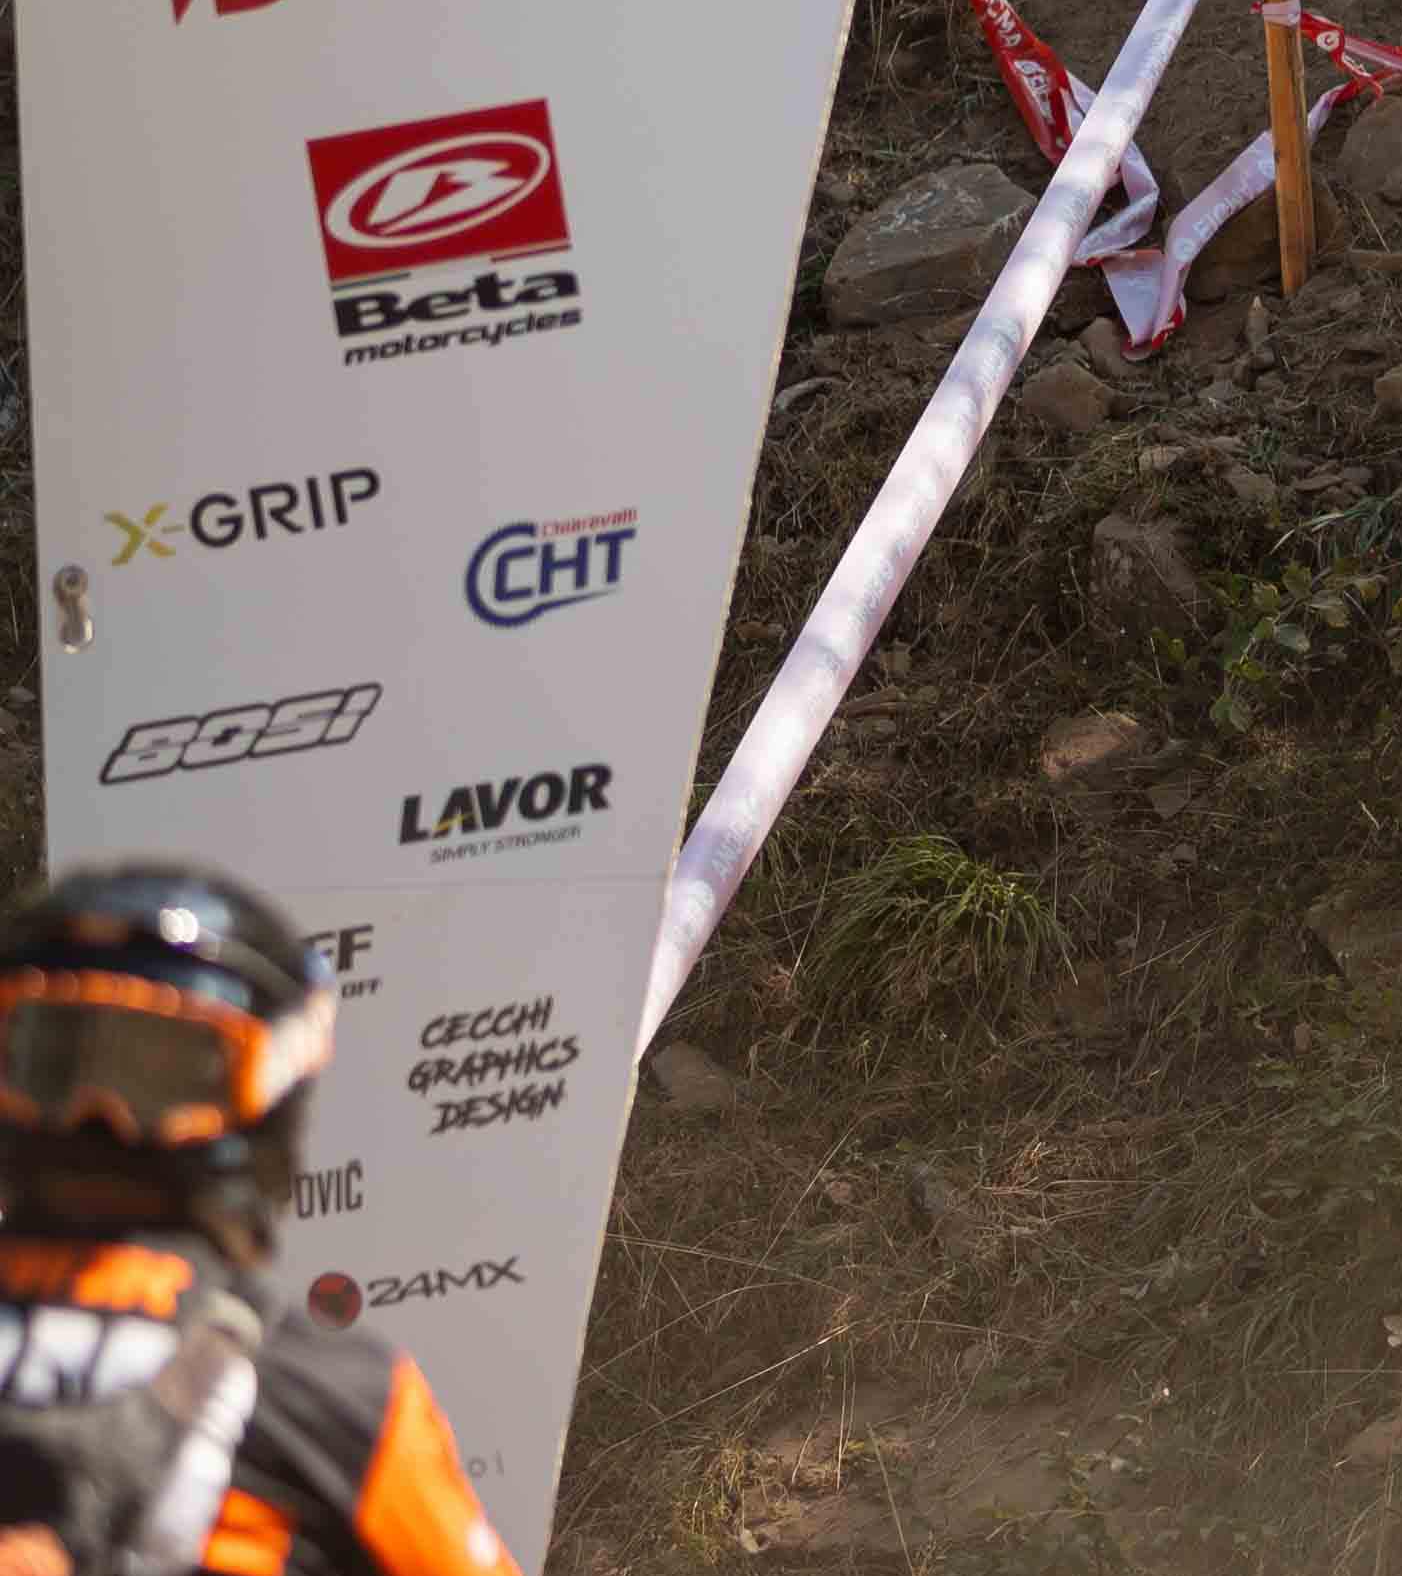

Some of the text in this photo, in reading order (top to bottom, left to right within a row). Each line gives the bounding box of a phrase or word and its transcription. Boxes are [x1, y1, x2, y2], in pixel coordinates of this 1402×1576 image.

[331, 265, 580, 338] Beta
[344, 307, 583, 367] motorcycles
[104, 467, 381, 566] X-GRIP
[397, 764, 613, 847] LAVOR
[430, 825, 582, 864] SIMPLY STRONGER
[420, 997, 554, 1048] CECCHI
[408, 1036, 580, 1091] GRAPHICS
[430, 1078, 564, 1135] DESIGN
[367, 1255, 526, 1308] 24MX
